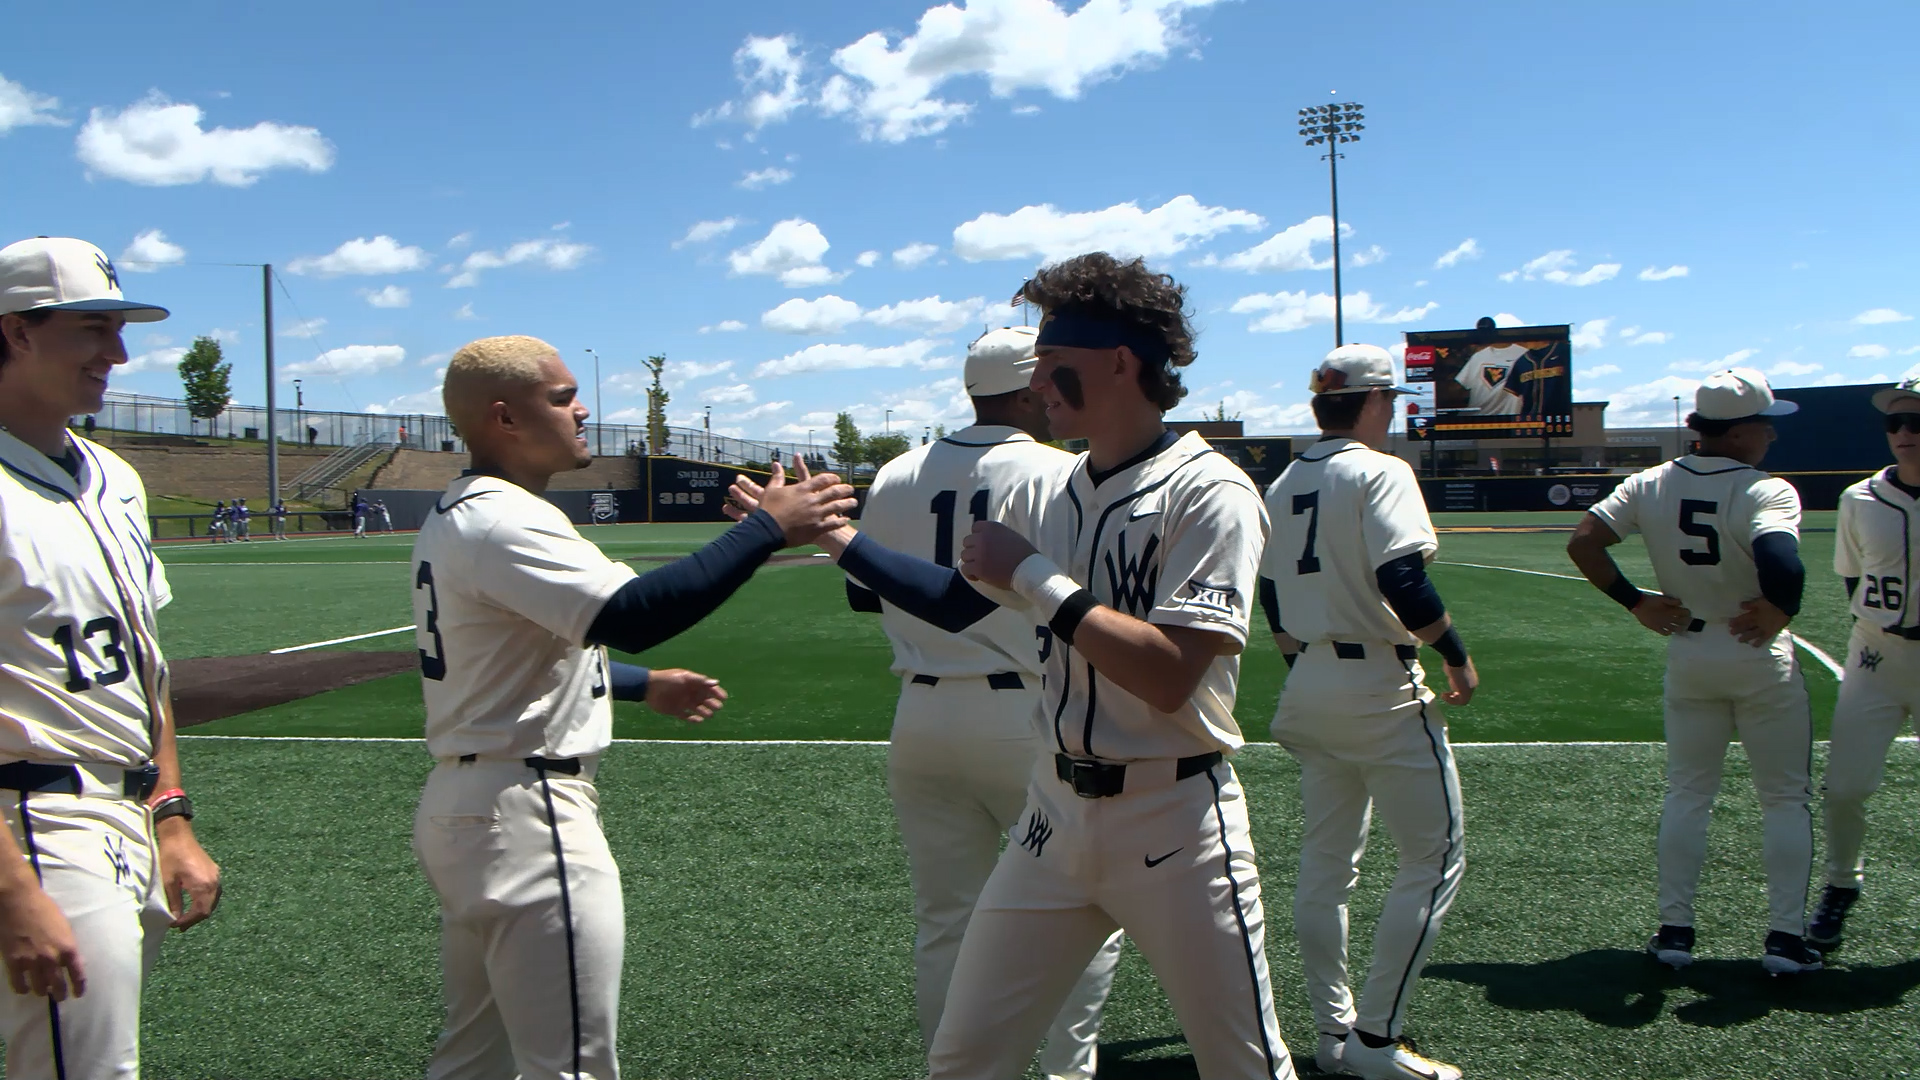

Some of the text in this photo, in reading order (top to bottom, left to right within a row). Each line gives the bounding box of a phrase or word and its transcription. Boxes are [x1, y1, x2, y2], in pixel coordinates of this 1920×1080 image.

[659, 492, 705, 505] 325
[1679, 498, 1722, 566] 5
[1292, 490, 1321, 576] 7
[1863, 574, 1902, 611] 26
[53, 616, 130, 693] 13
